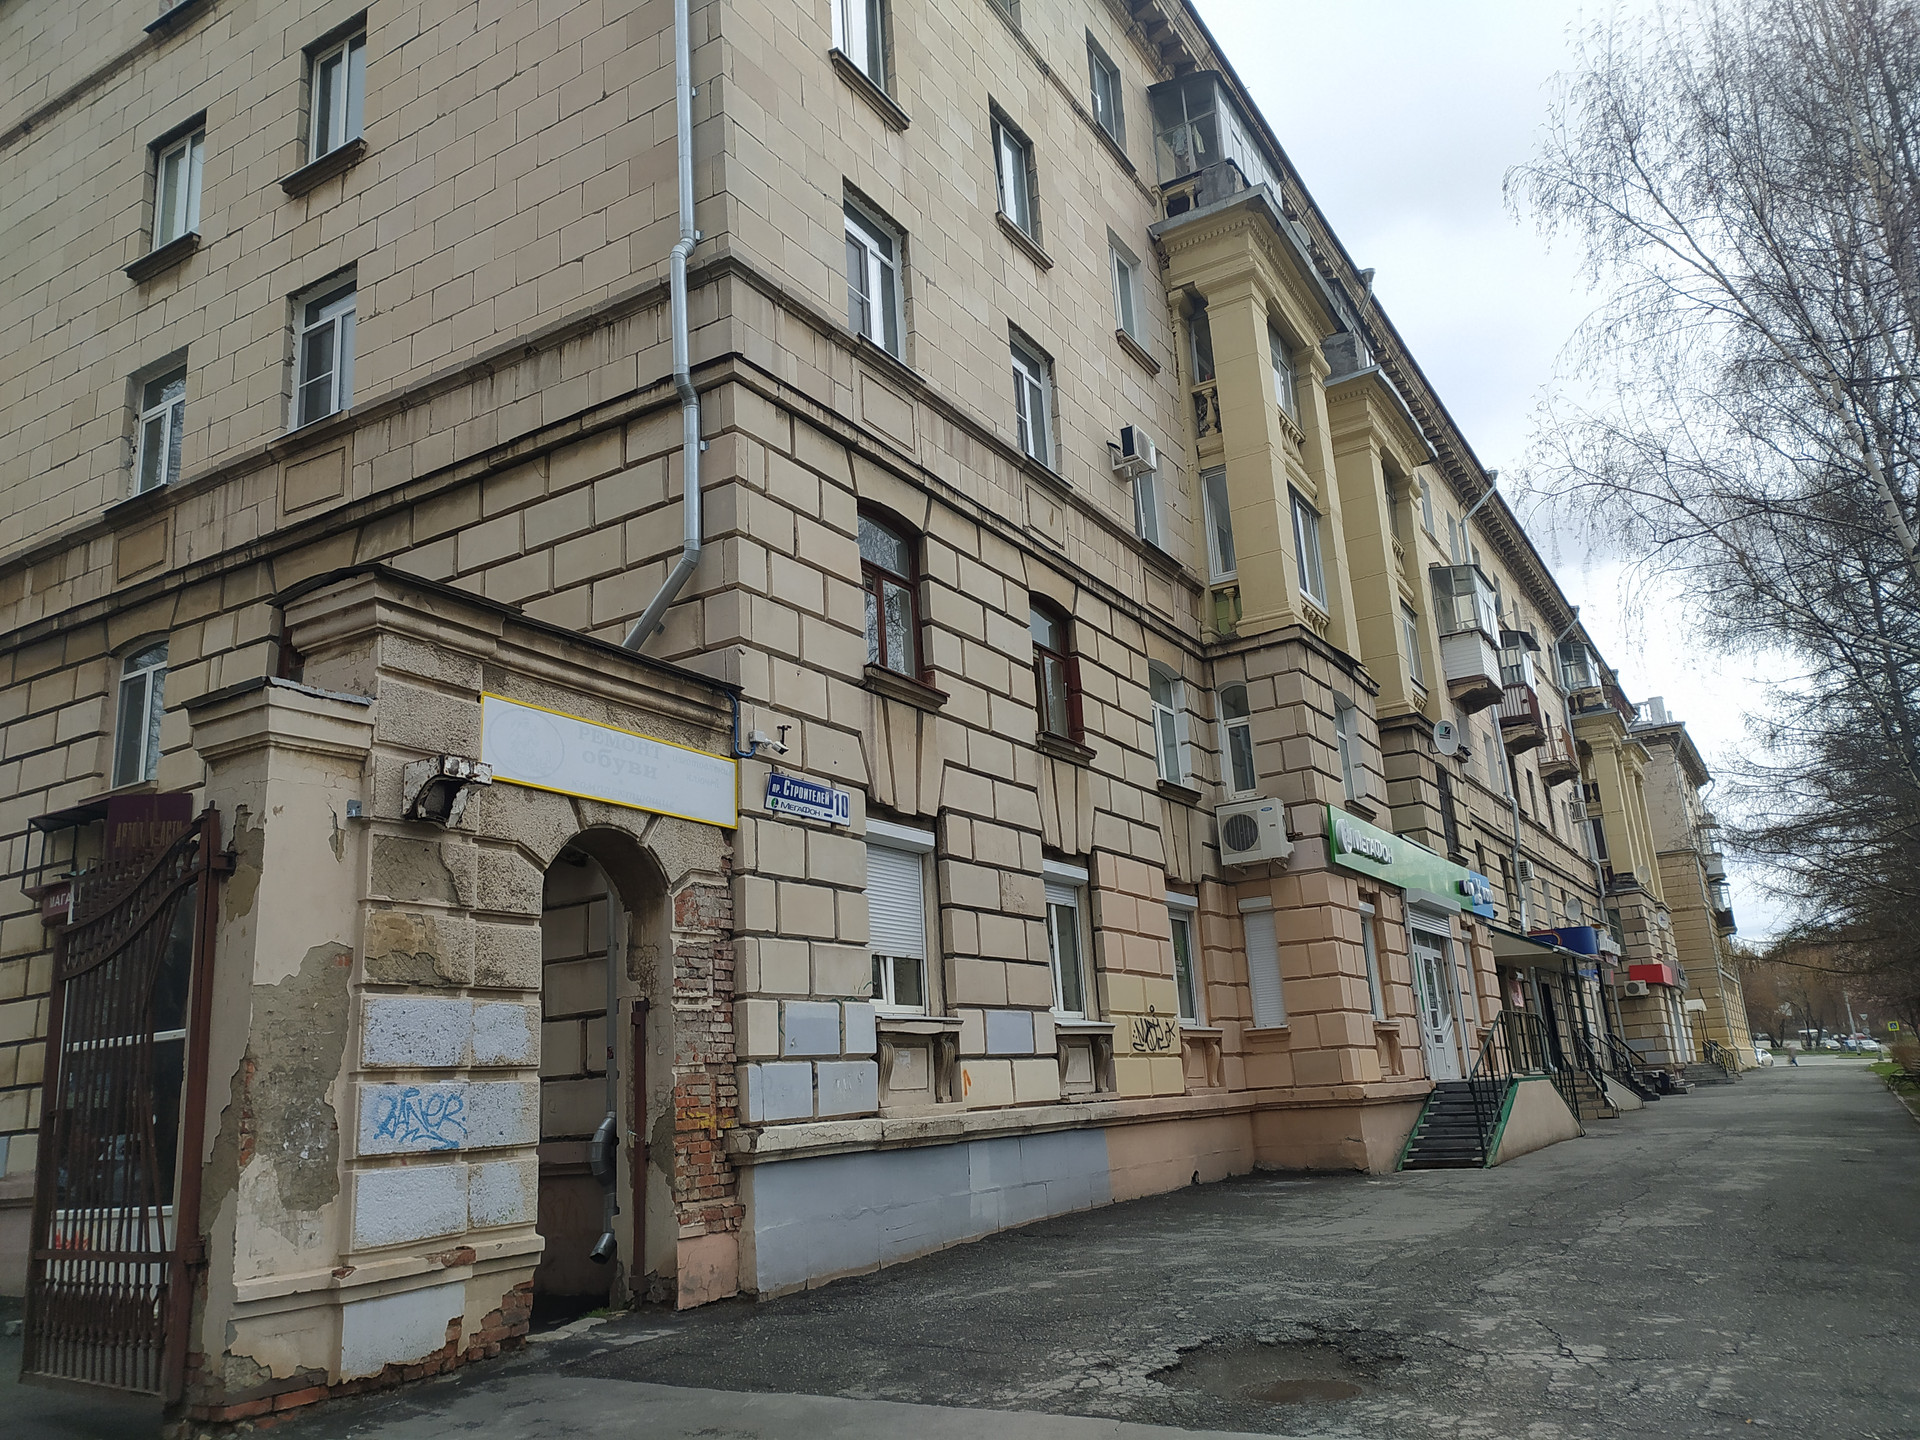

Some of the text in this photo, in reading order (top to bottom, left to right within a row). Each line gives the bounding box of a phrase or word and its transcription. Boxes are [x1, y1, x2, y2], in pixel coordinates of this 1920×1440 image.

[577, 725, 662, 760] РЕМОНТ
[582, 749, 658, 780] обуви
[834, 793, 849, 819] 10
